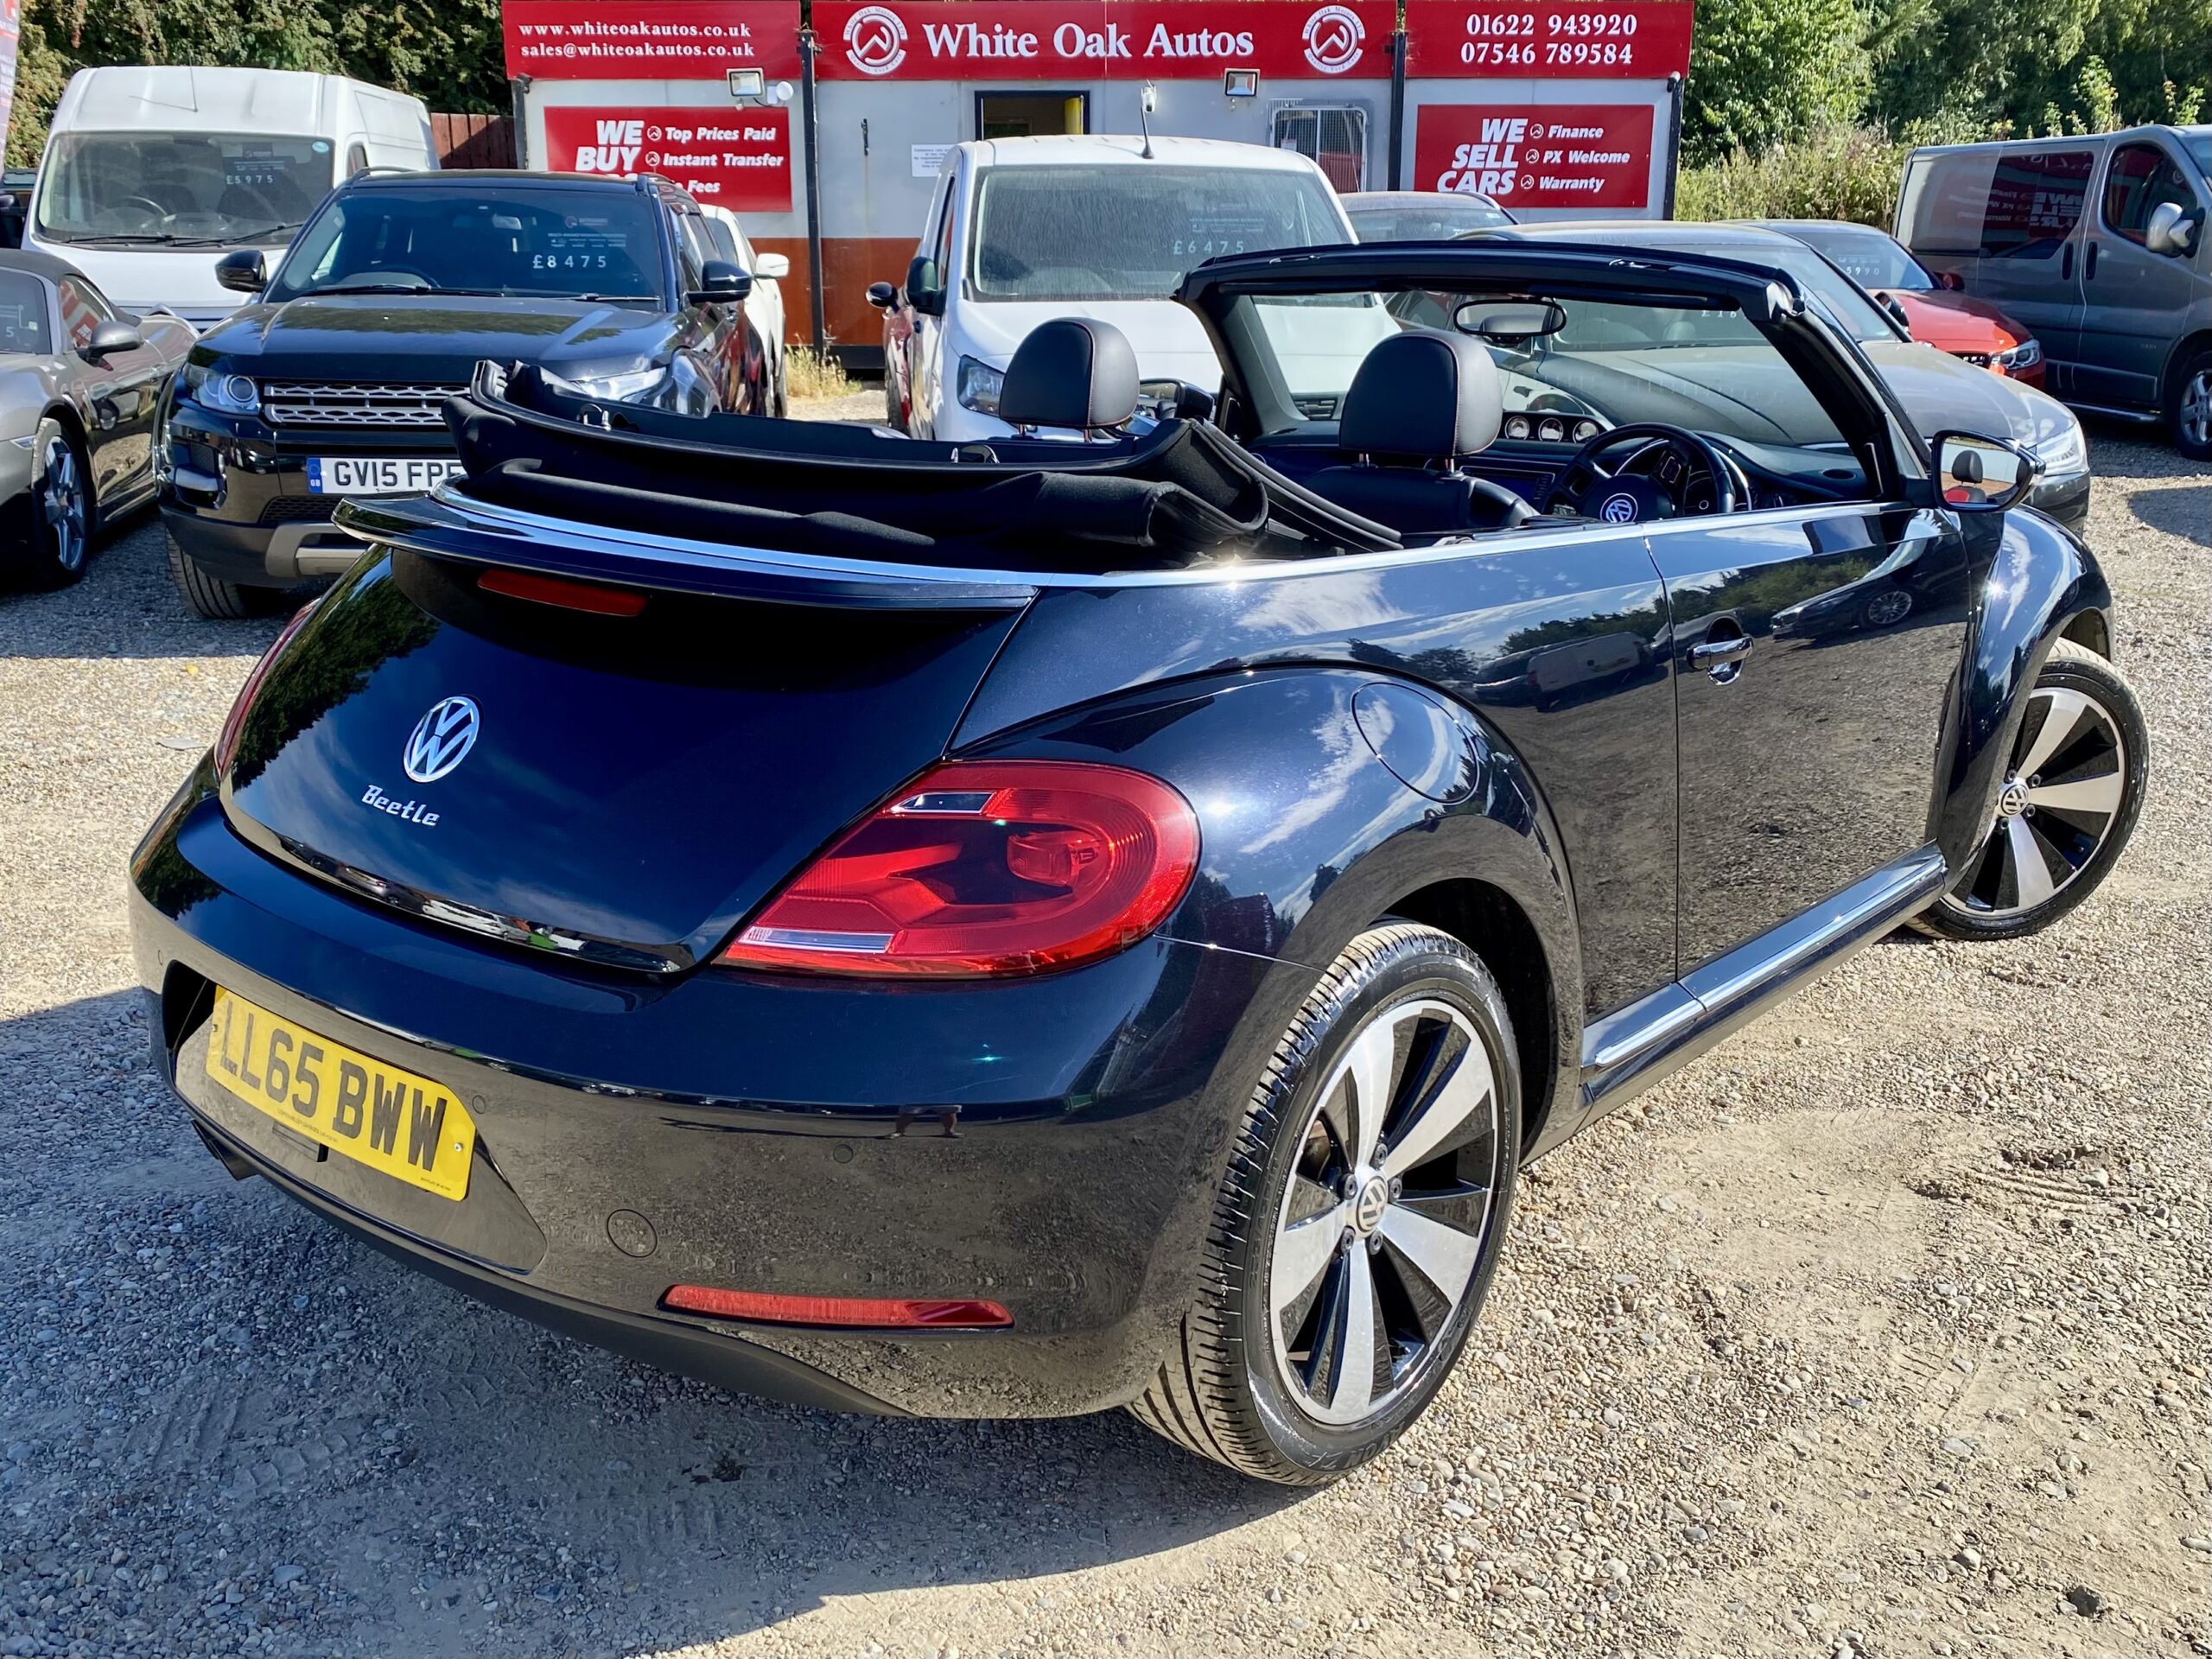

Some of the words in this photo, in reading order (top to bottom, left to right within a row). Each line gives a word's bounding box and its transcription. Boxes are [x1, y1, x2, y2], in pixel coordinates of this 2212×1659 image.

[518, 21, 752, 37] www.whiteoakautos.co.uk
[1466, 14, 1535, 35] 01622
[1548, 14, 1637, 36] 943920
[921, 22, 1039, 58] White
[1052, 22, 1133, 58] Oak
[1142, 23, 1255, 57] Autos
[521, 42, 755, 58] sales@whiteoakautos.co.uk
[1460, 42, 1536, 65] 07546
[1546, 42, 1633, 65] 789584
[596, 120, 645, 146] WE
[664, 126, 693, 143] Top
[696, 126, 741, 142] Prices
[743, 127, 777, 142] Paid
[1481, 118, 1529, 144] WE
[1548, 124, 1605, 139] Finance
[575, 146, 642, 173] BUY
[663, 152, 718, 167] Instant
[722, 152, 785, 168] Transfer
[1451, 143, 1519, 169] SELL
[1542, 150, 1564, 164] PX
[1568, 150, 1630, 164] Welcome
[226, 175, 274, 185] £5975
[687, 179, 721, 194] Fees
[1437, 169, 1516, 195] CARS
[1539, 176, 1605, 193] Warranty
[1173, 240, 1245, 256] £6475
[532, 254, 607, 270] £8475
[334, 461, 398, 487] GV15
[361, 784, 441, 827] Beetle
[219, 1000, 325, 1119] LL65
[332, 1058, 448, 1173] BWW
